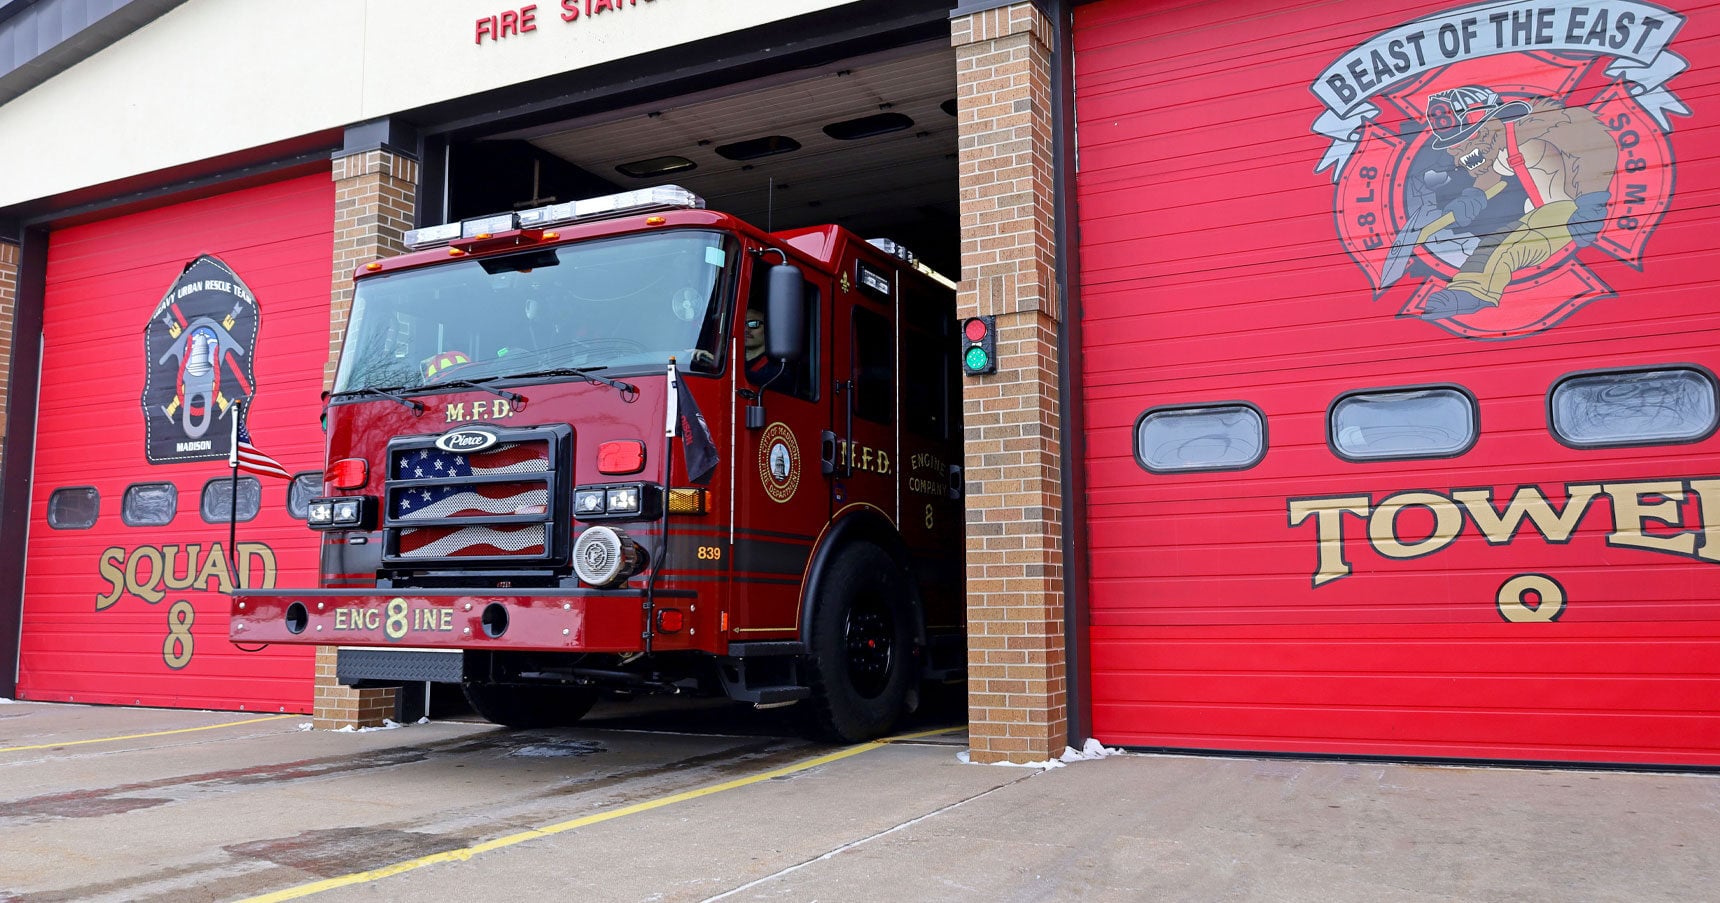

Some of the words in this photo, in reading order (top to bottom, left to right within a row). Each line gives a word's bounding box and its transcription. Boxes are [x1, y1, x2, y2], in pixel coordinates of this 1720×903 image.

[475, 4, 537, 45] FIRE
[1326, 30, 1426, 106] BEAST
[1438, 17, 1478, 59] OF
[1489, 7, 1556, 48] THE
[1565, 7, 1664, 55] EAST
[1430, 103, 1456, 132] 8
[1609, 112, 1647, 174] SQ-8
[1356, 165, 1378, 203] L-8
[1616, 183, 1648, 231] M-8
[1357, 211, 1384, 250] E-8
[178, 281, 203, 299] URBAN
[205, 280, 231, 293] RESCUE
[233, 284, 252, 305] TEAM
[445, 399, 514, 423] M.F.D.
[176, 440, 212, 452] MADISON
[450, 434, 483, 449] Pierce
[770, 426, 778, 437] OF
[778, 426, 798, 460] MADISON
[841, 440, 892, 475] M.F.D.
[761, 463, 770, 485] FIRE
[769, 470, 798, 498] DEPARTMENT
[911, 452, 946, 477] ENGINE
[909, 477, 947, 496] COMPANY
[924, 503, 934, 530] 8
[1287, 476, 1720, 590] TOWE
[697, 546, 721, 560] 839
[95, 541, 277, 612] SQUAD
[162, 600, 195, 670] 8
